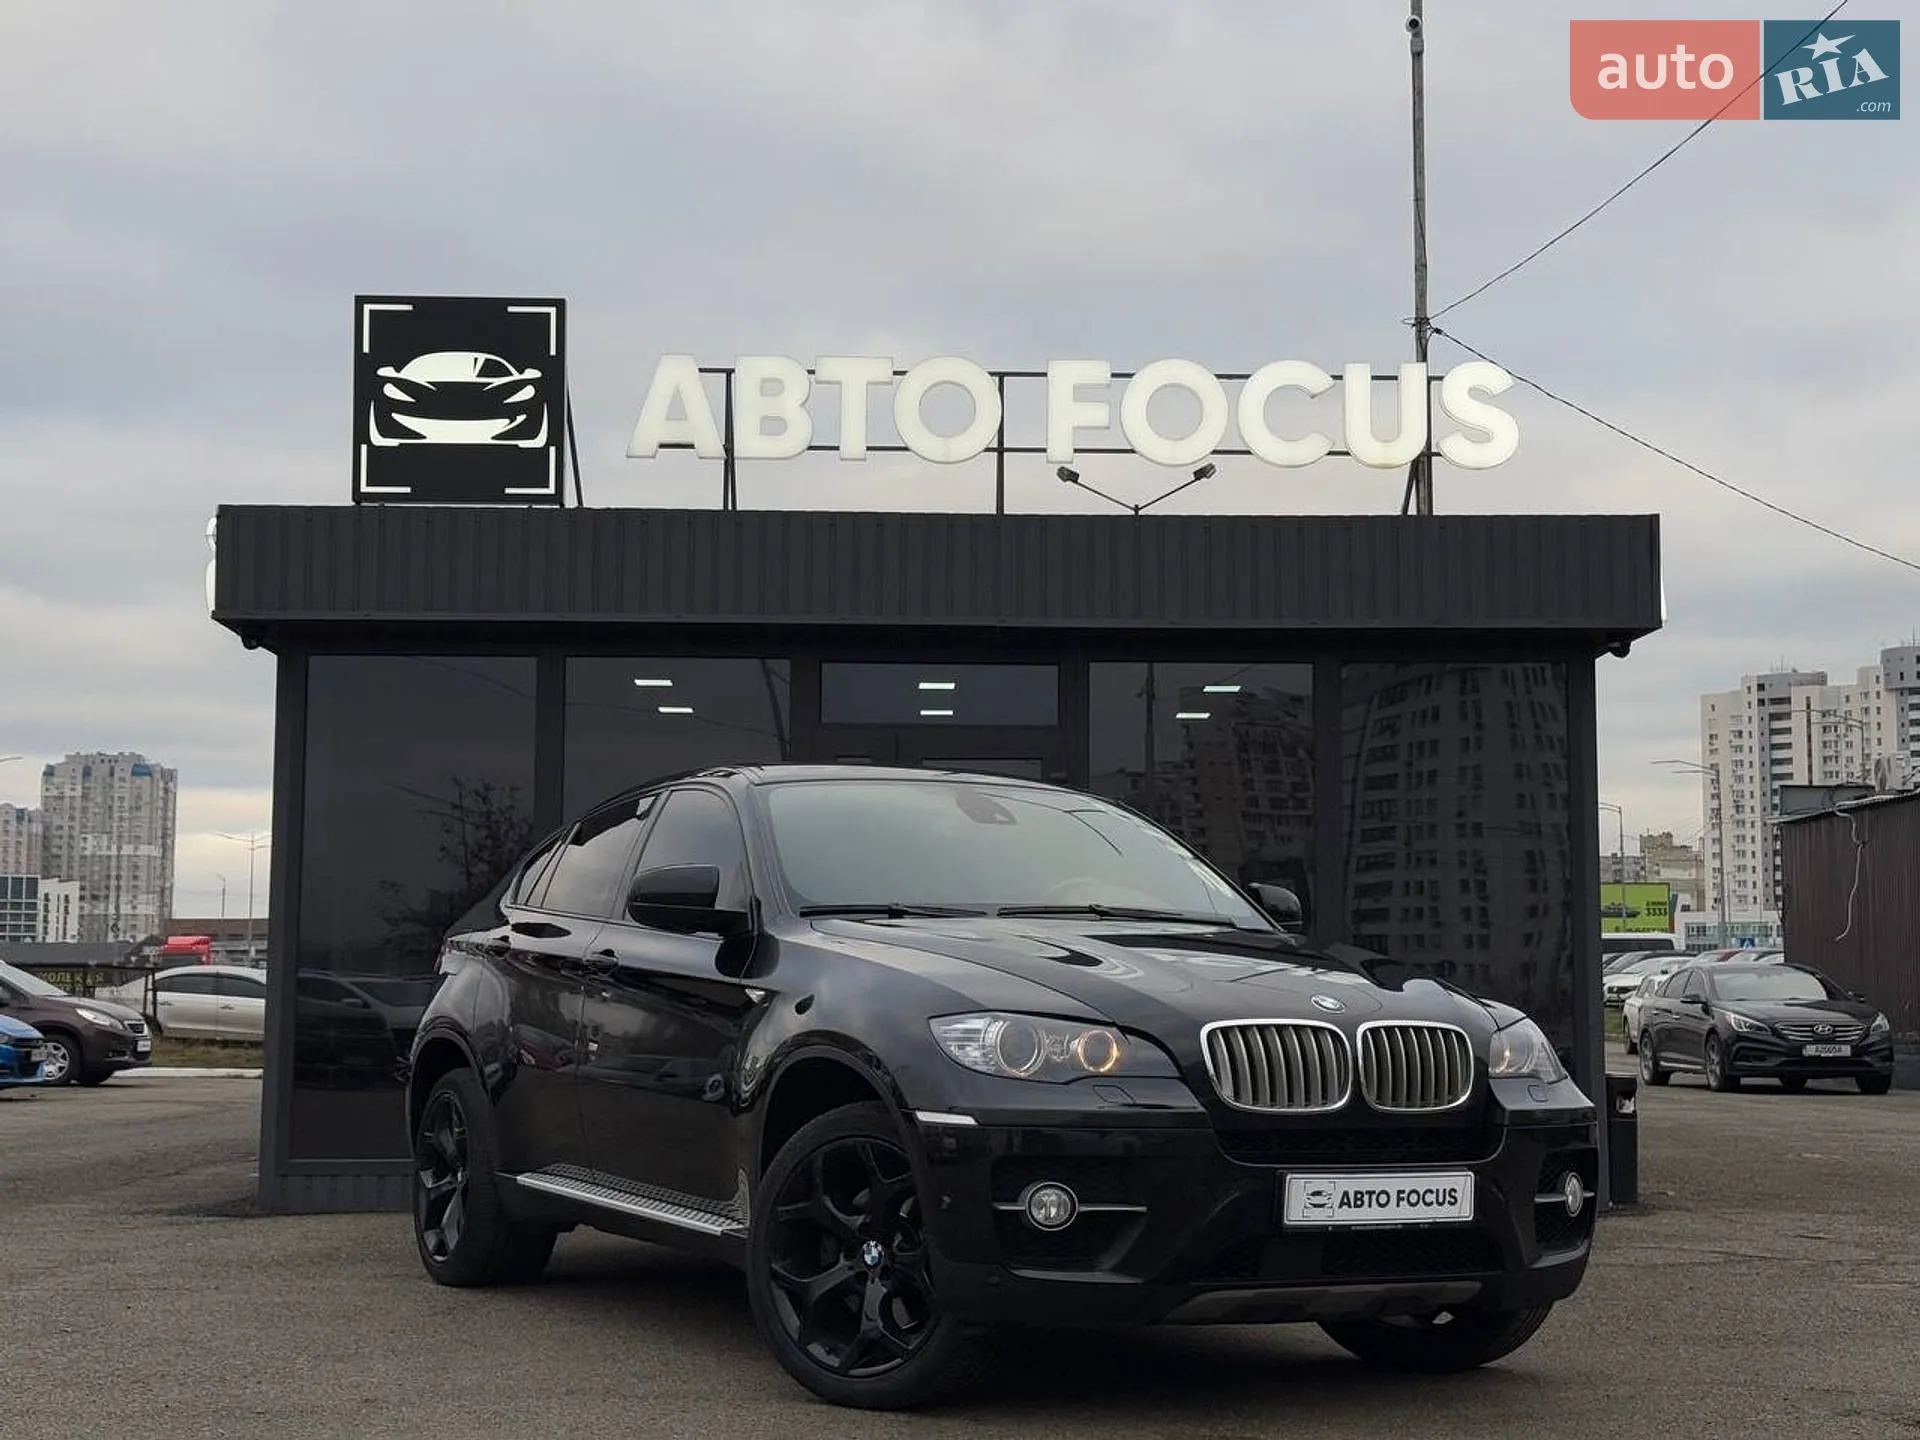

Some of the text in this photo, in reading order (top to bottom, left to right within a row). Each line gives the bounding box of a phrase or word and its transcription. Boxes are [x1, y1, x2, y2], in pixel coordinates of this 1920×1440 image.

[627, 354, 1521, 470] АВТО FOCUS
[1338, 1187, 1458, 1209] АВТО FOCUS
